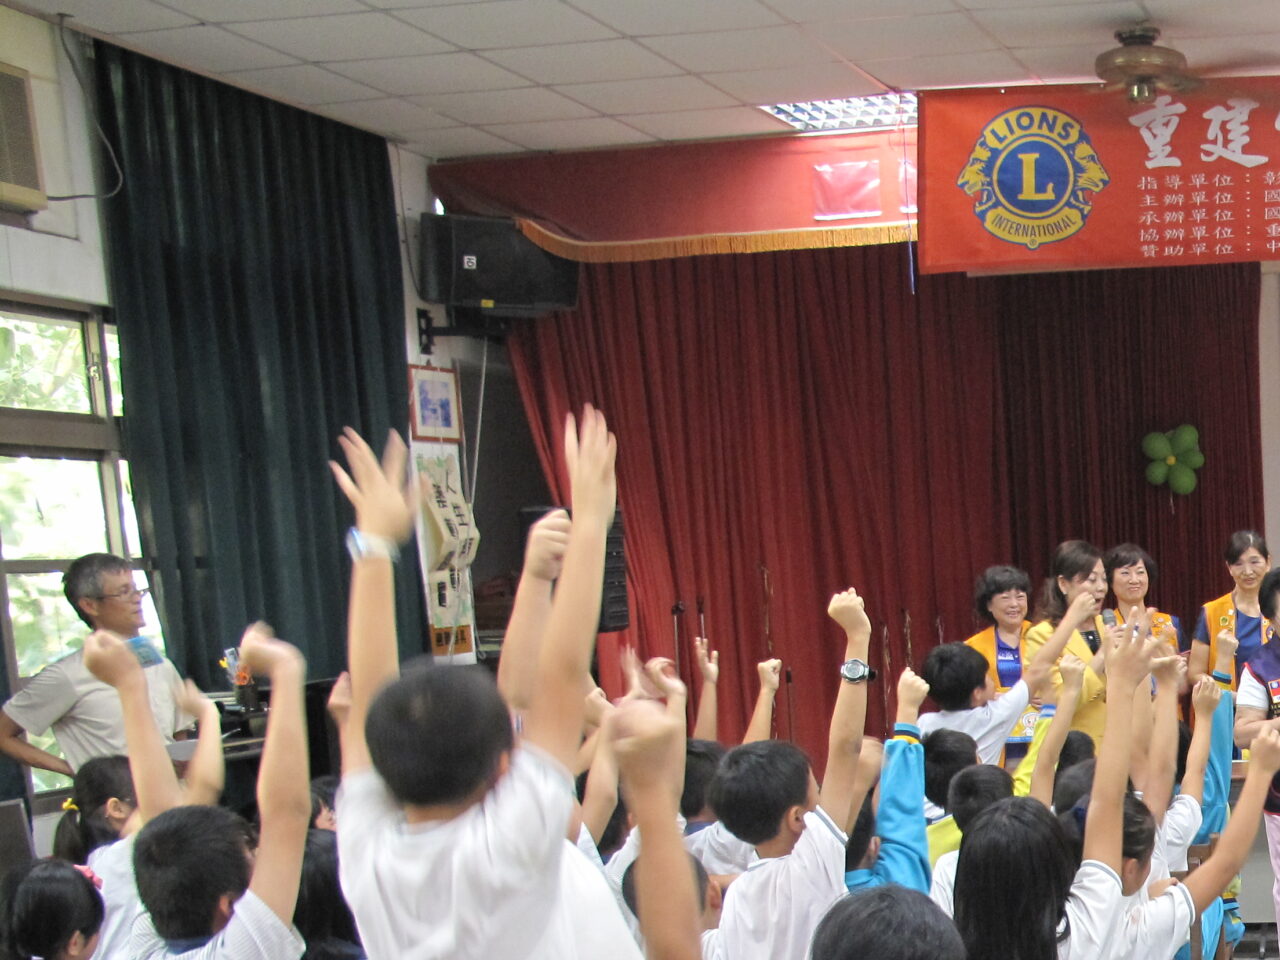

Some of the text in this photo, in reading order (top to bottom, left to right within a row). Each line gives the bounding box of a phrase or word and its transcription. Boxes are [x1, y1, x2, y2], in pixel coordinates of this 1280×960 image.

[990, 111, 1075, 144] LIONS
[1017, 153, 1056, 200] L
[991, 214, 1077, 238] INTERNATIONAL
